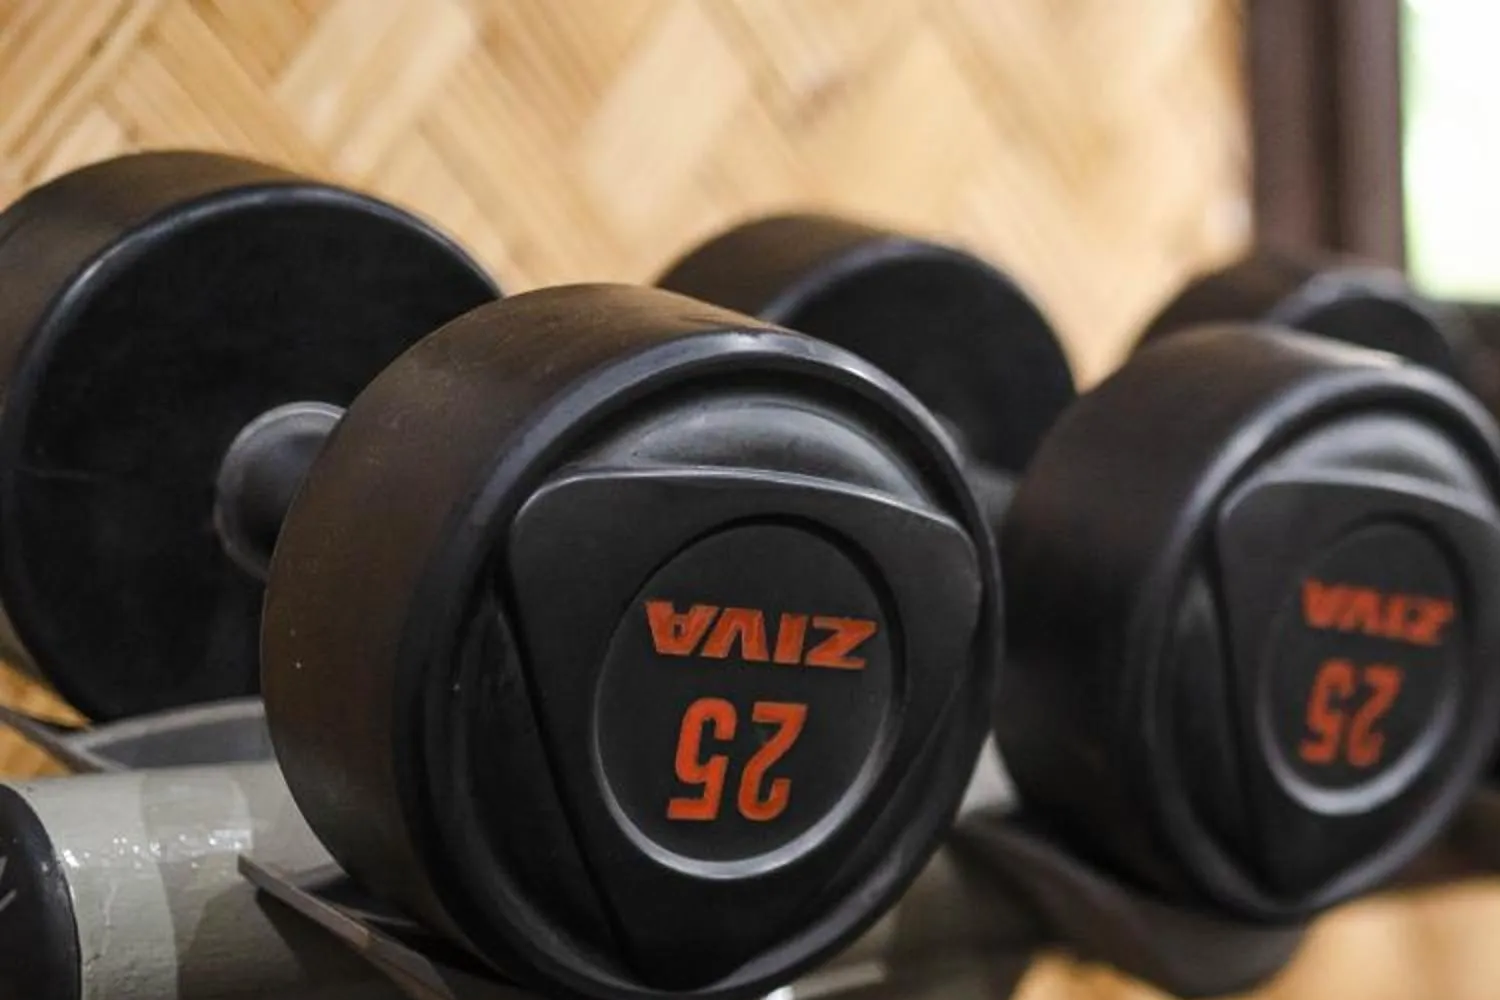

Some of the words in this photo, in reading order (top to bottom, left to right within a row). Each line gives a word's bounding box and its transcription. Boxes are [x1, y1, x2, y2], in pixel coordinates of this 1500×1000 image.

[645, 600, 876, 669] ZIVA
[666, 697, 808, 822] 25
[1301, 658, 1402, 767] 25
